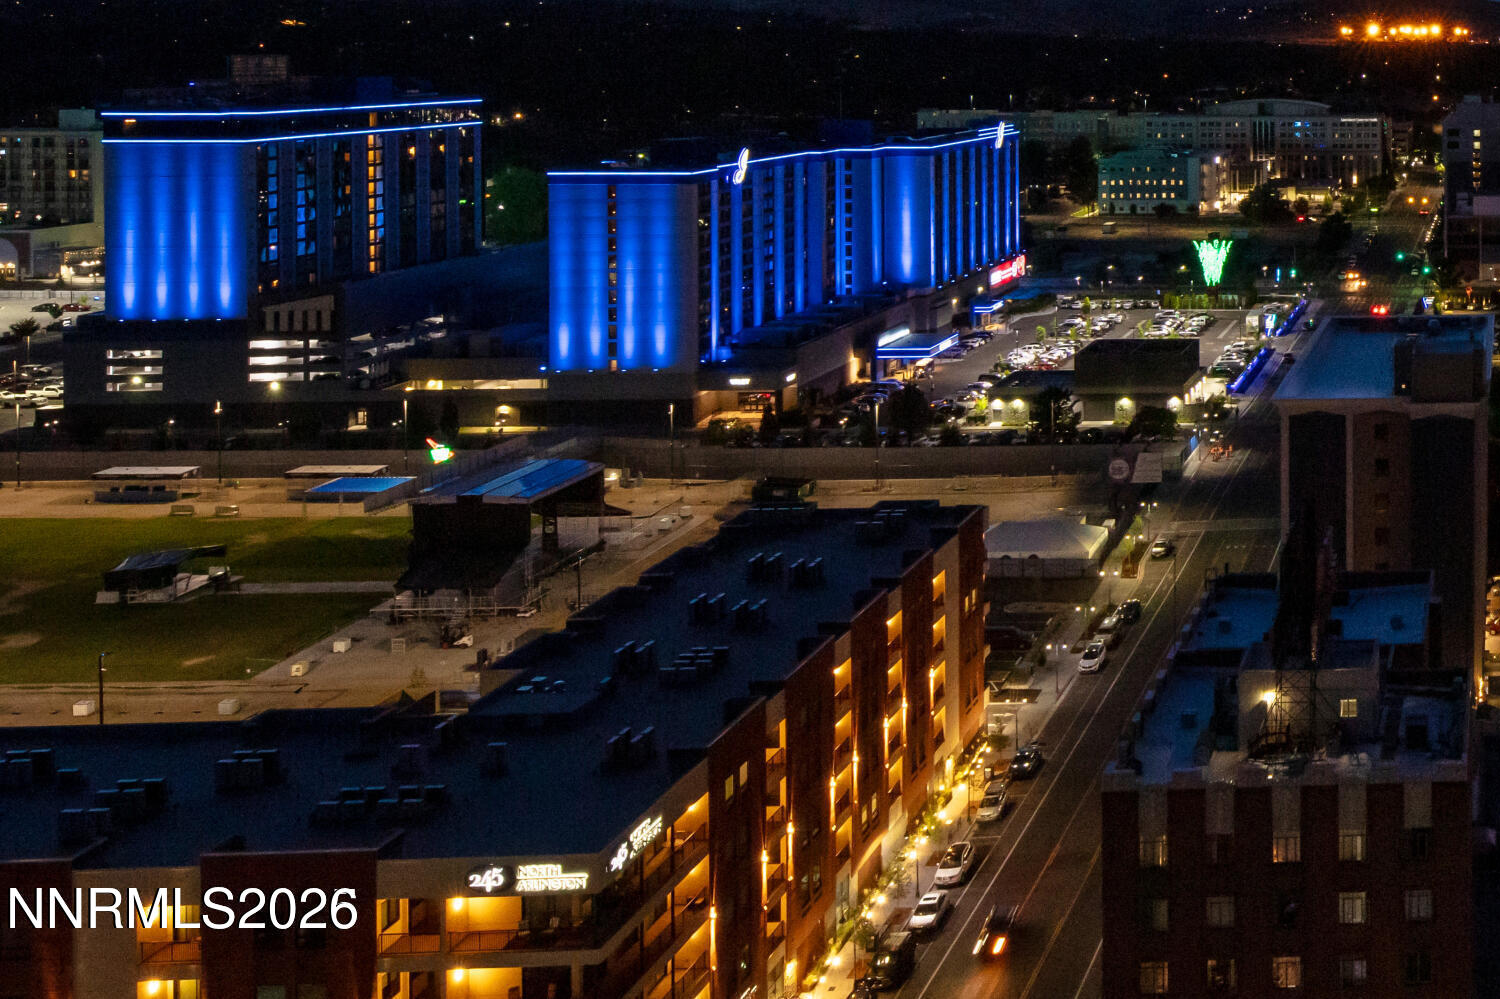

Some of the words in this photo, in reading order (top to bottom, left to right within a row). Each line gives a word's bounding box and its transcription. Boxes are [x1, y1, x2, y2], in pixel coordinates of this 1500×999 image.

[518, 864, 562, 879] NORTH
[468, 867, 504, 893] 245
[515, 878, 588, 892] ARLINGTON
